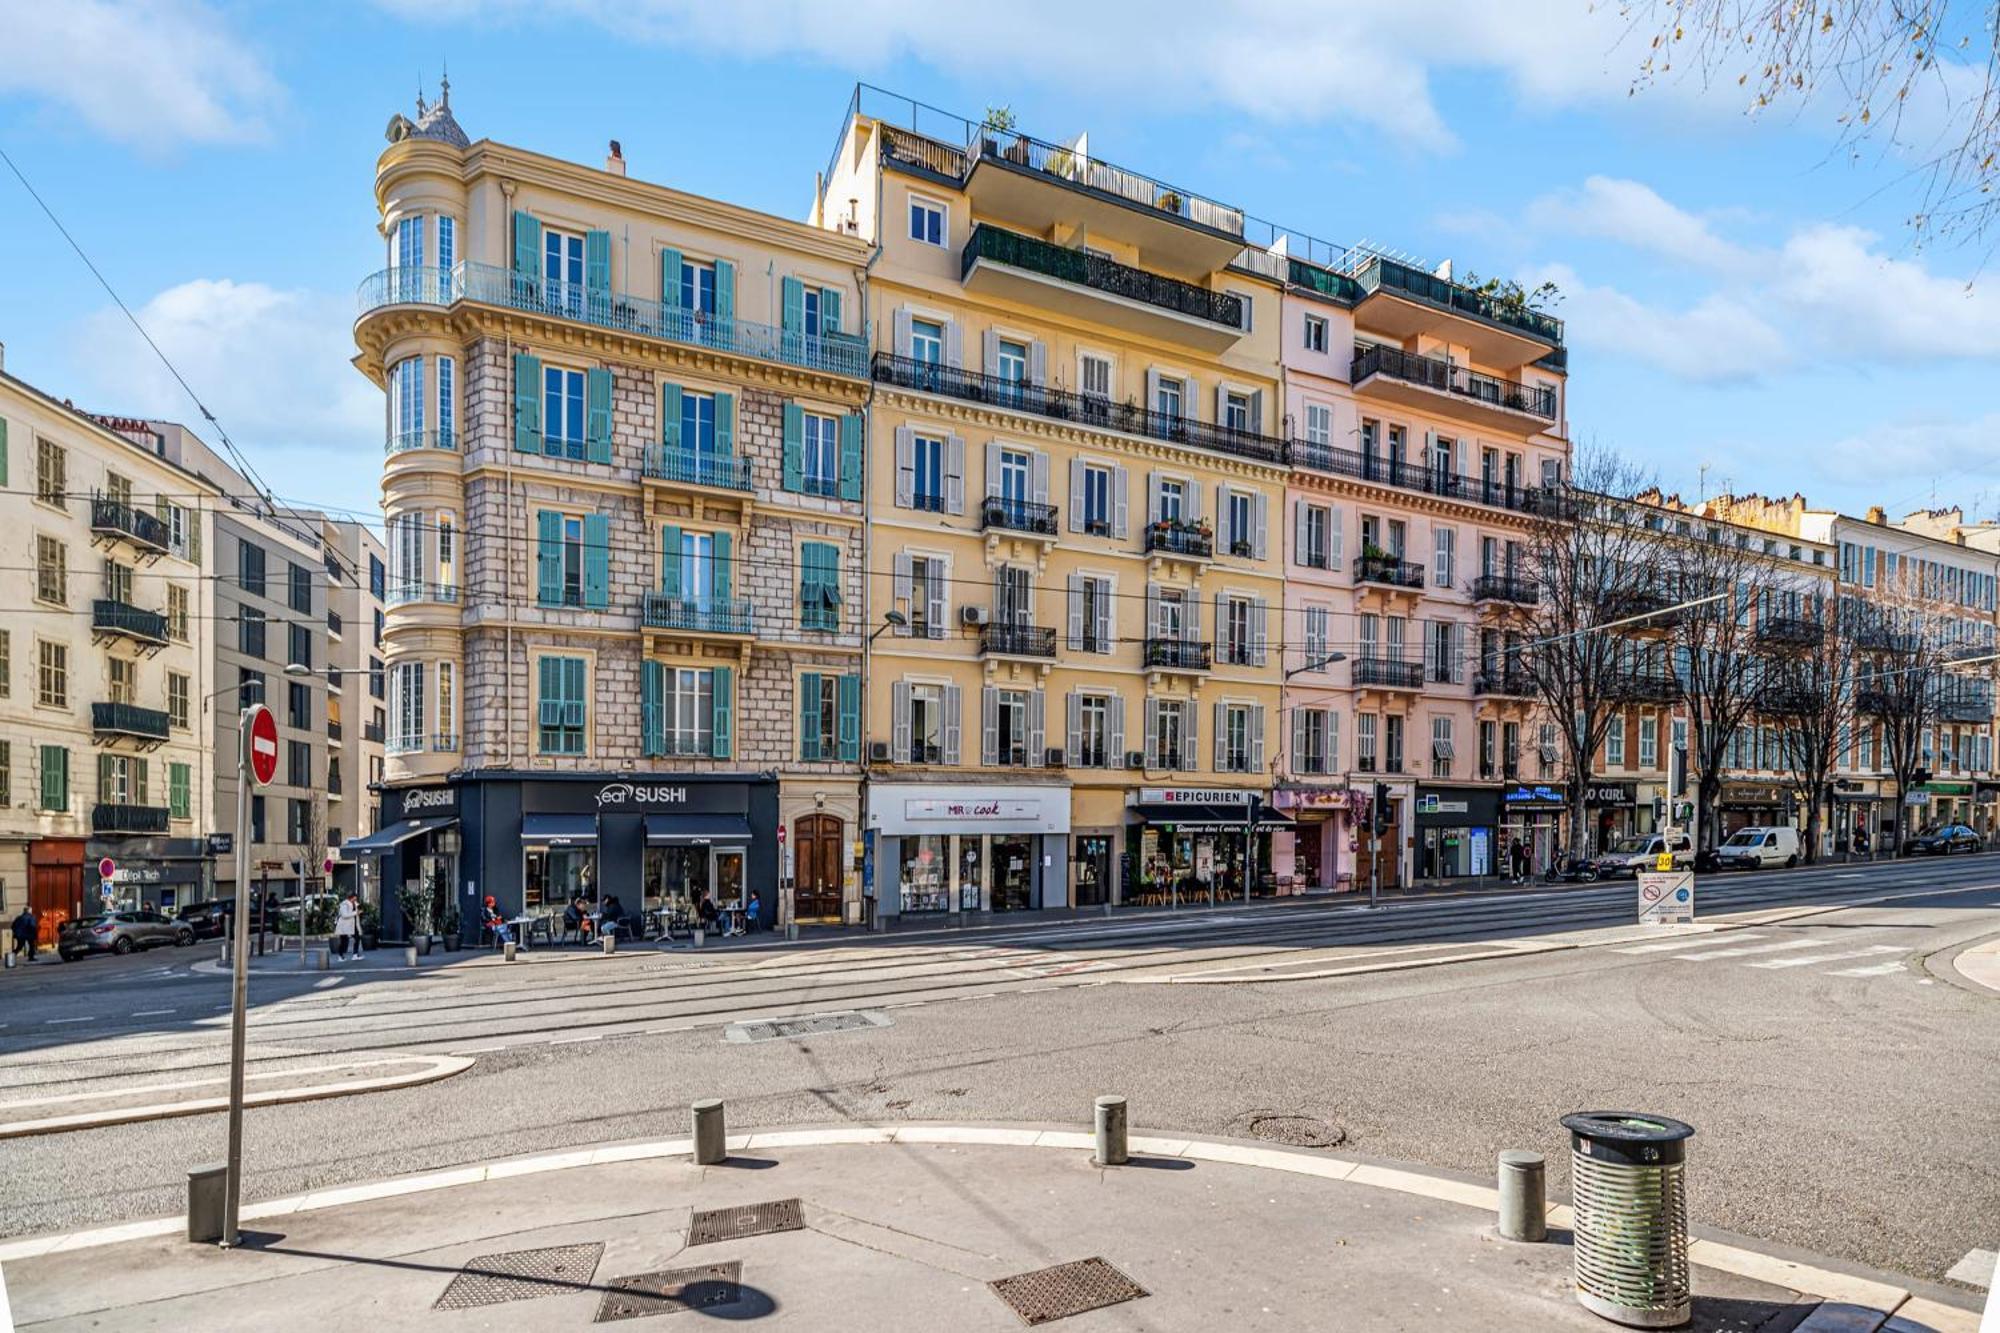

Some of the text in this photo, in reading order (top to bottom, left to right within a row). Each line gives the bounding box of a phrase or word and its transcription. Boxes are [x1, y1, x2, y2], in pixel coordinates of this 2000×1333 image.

[423, 789, 454, 806] SUSHI
[635, 787, 686, 802] SUSHI
[1176, 791, 1240, 802] EPICURIEN
[1599, 789, 1626, 801] CURL
